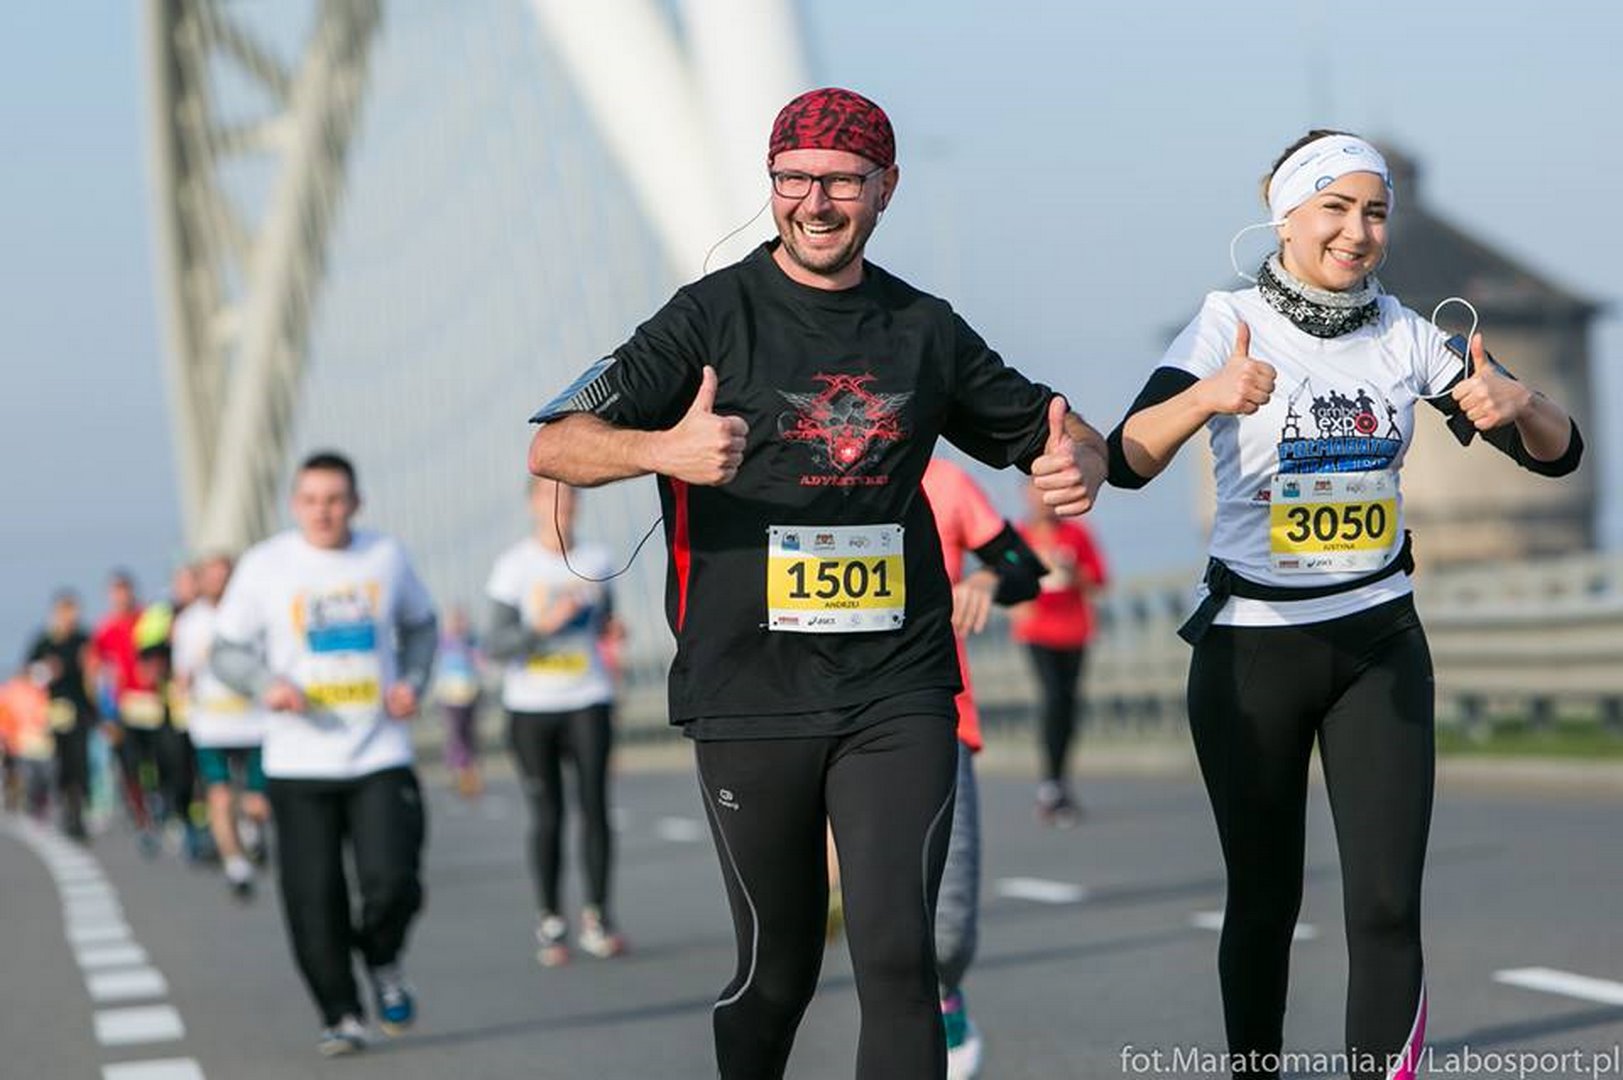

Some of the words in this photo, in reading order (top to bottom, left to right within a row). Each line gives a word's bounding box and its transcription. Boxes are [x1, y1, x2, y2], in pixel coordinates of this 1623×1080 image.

[1317, 405, 1363, 418] amber
[1286, 503, 1386, 542] 3050
[787, 560, 891, 599] 1501
